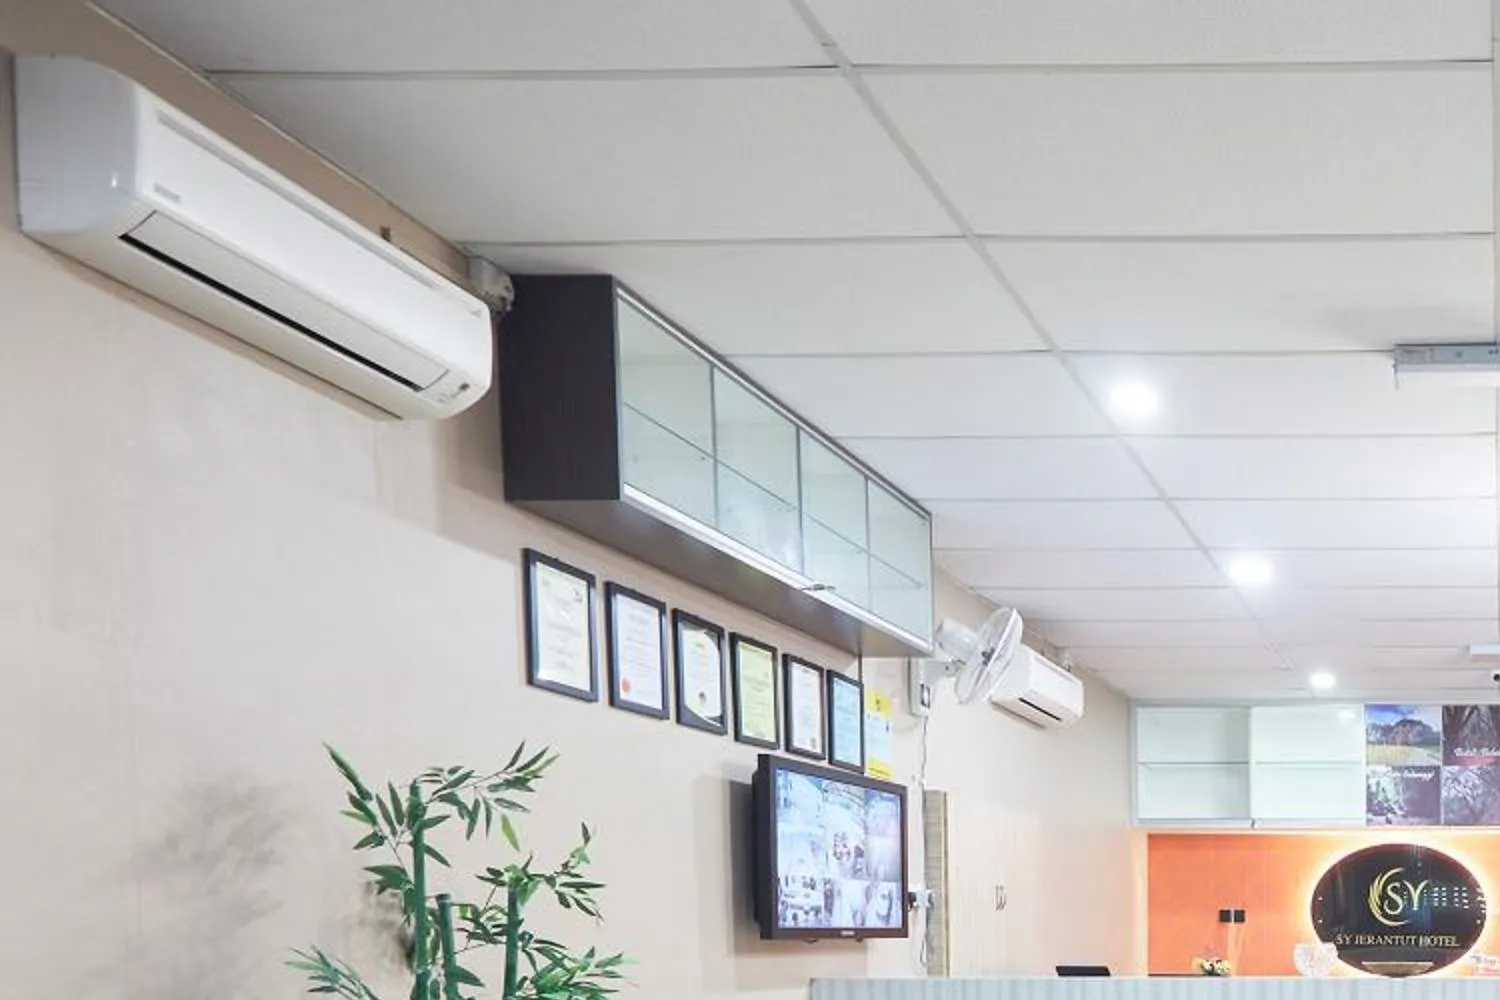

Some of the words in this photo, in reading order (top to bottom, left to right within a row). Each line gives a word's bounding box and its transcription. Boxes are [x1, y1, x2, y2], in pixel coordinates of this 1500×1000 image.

[1336, 934, 1353, 945] SY
[1354, 934, 1418, 946] JERANTUT
[1419, 935, 1461, 947] HOTEL
